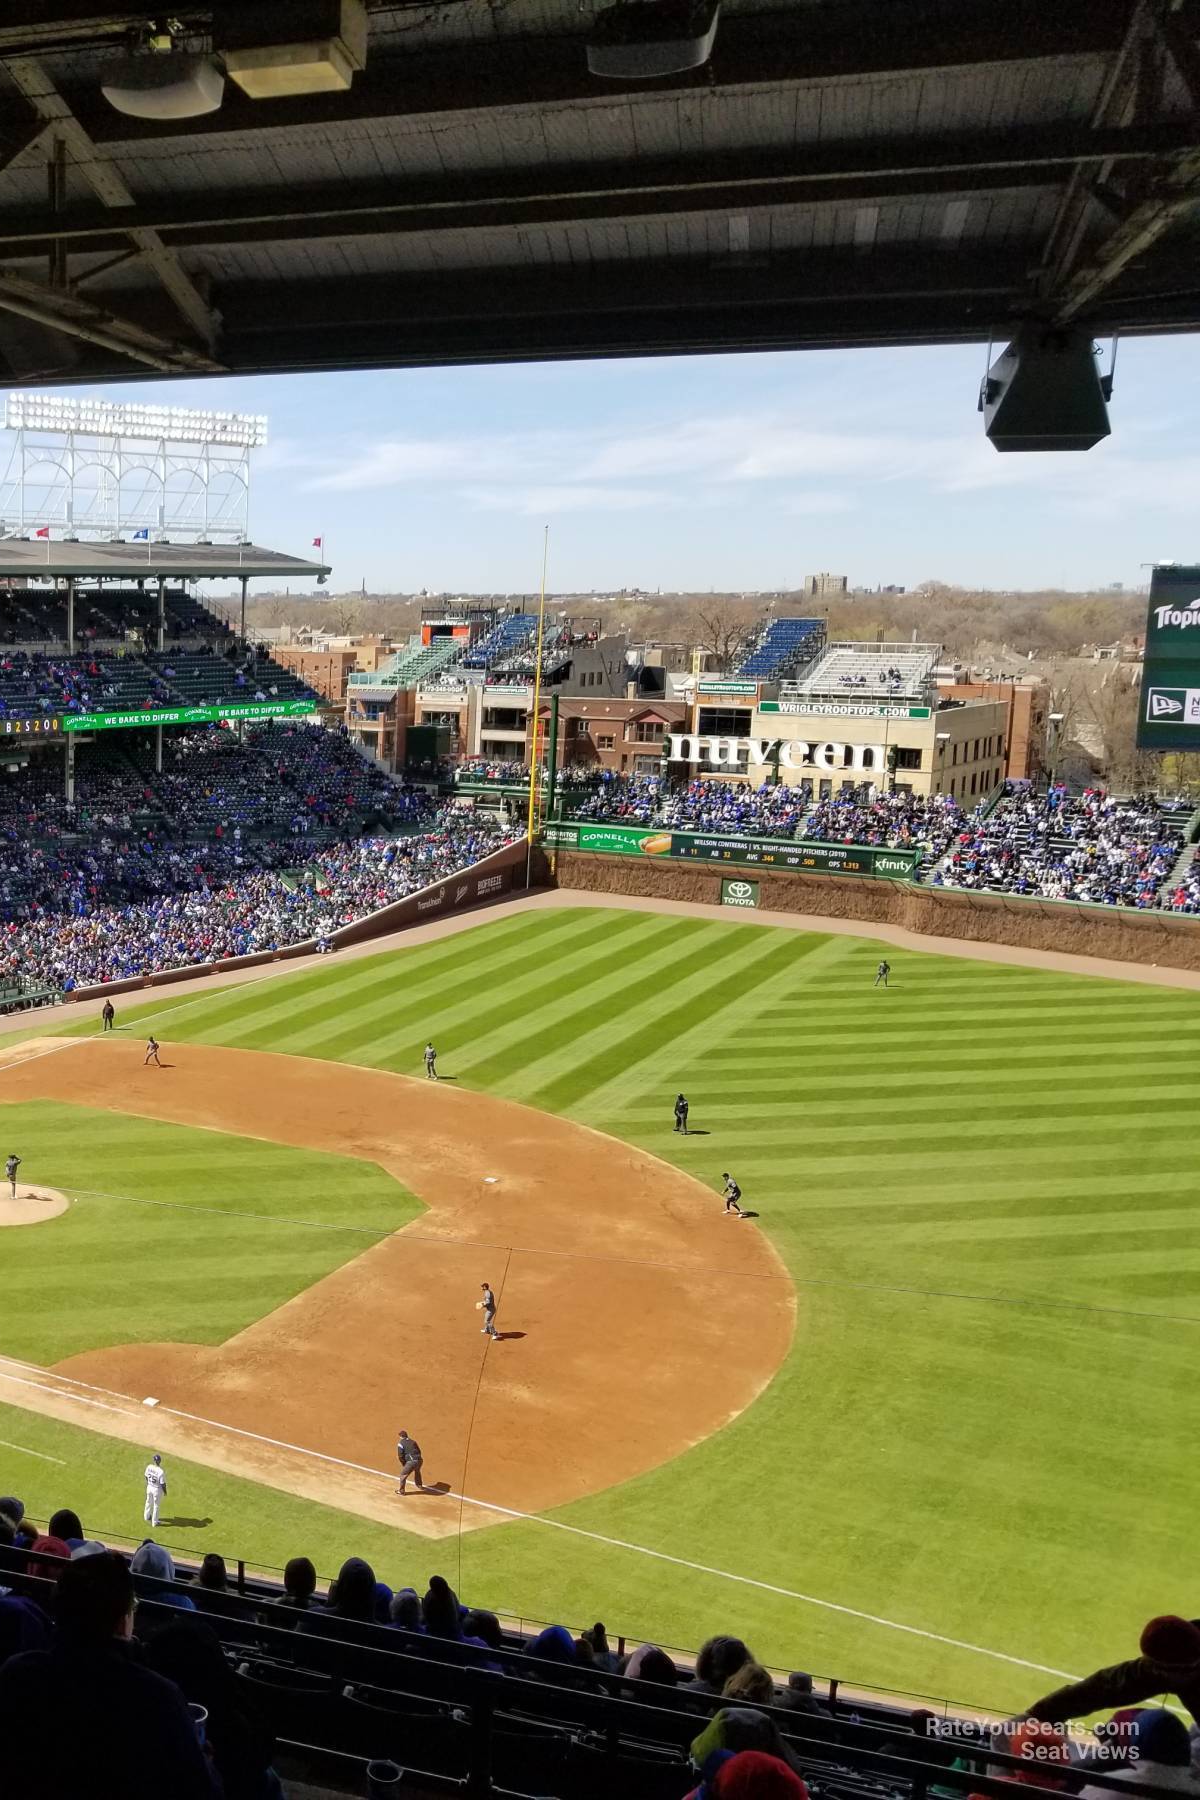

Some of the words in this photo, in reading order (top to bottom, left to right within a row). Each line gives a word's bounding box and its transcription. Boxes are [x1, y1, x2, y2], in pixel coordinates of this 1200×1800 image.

[1154, 603, 1200, 629] Tropi
[218, 709, 230, 717] WE
[231, 708, 249, 716] BAKE
[250, 707, 260, 715] TO
[261, 706, 285, 714] DIFFER
[66, 716, 97, 726] GONNELLA
[104, 717, 117, 725] WE
[118, 715, 139, 724] BAKE
[141, 715, 151, 723] TO
[152, 713, 179, 722] DIFFER
[6, 722, 12, 733] B
[15, 722, 21, 733] 2
[25, 721, 30, 732] S
[34, 720, 40, 732] 2
[667, 733, 891, 774] nuveen
[582, 833, 636, 846] GONNELLA
[693, 839, 717, 847] WILLSON
[718, 841, 748, 849] CONTRERAS
[762, 845, 802, 854] RIGHT-HANDED
[802, 848, 828, 857] PITCHERS
[828, 850, 847, 859] (2019)
[787, 857, 799, 865] OBP
[801, 858, 815, 866] .500
[828, 860, 840, 868] OPS
[875, 858, 913, 873] xfinity
[723, 896, 755, 907] TOYOTA
